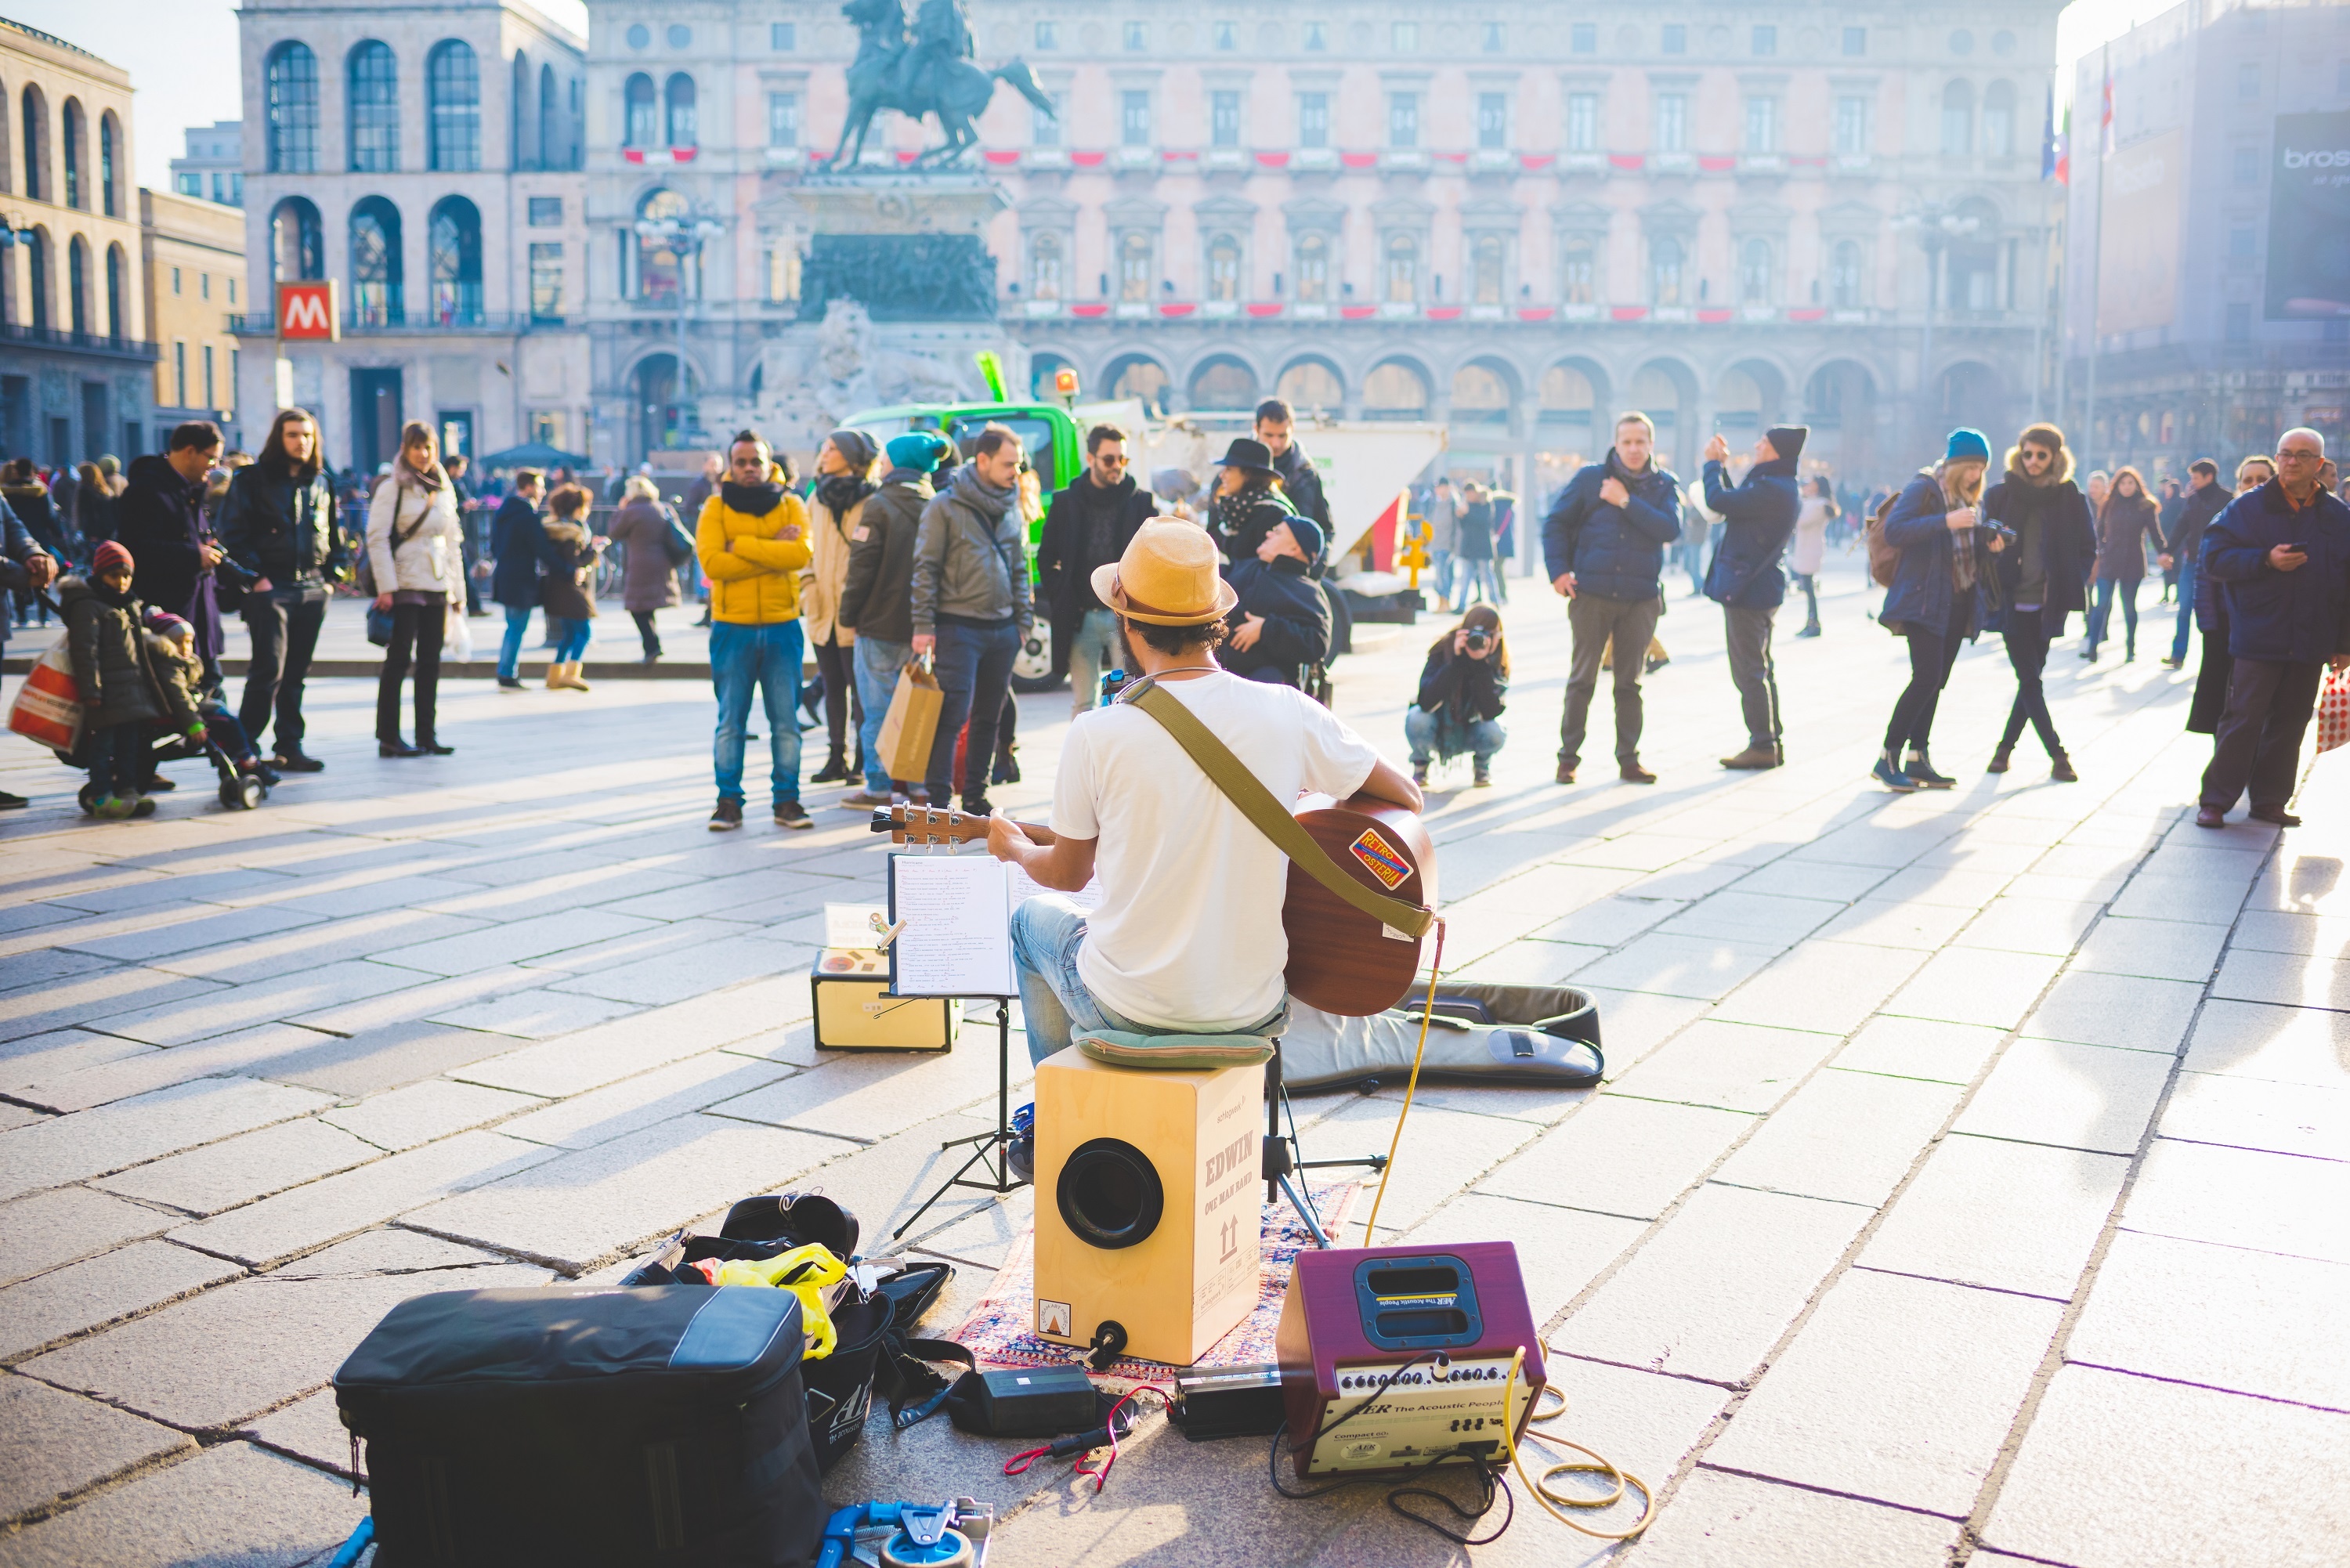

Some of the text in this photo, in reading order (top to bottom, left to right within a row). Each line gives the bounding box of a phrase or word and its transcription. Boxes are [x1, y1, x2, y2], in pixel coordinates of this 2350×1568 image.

[284, 294, 329, 329] M
[1361, 833, 1393, 859] RETRO
[1364, 854, 1400, 886] OSTERIA
[1206, 1129, 1253, 1187] EDWIN
[1205, 1171, 1252, 1216] ONE MAN BAND
[1417, 1402, 1466, 1411] Acoustic
